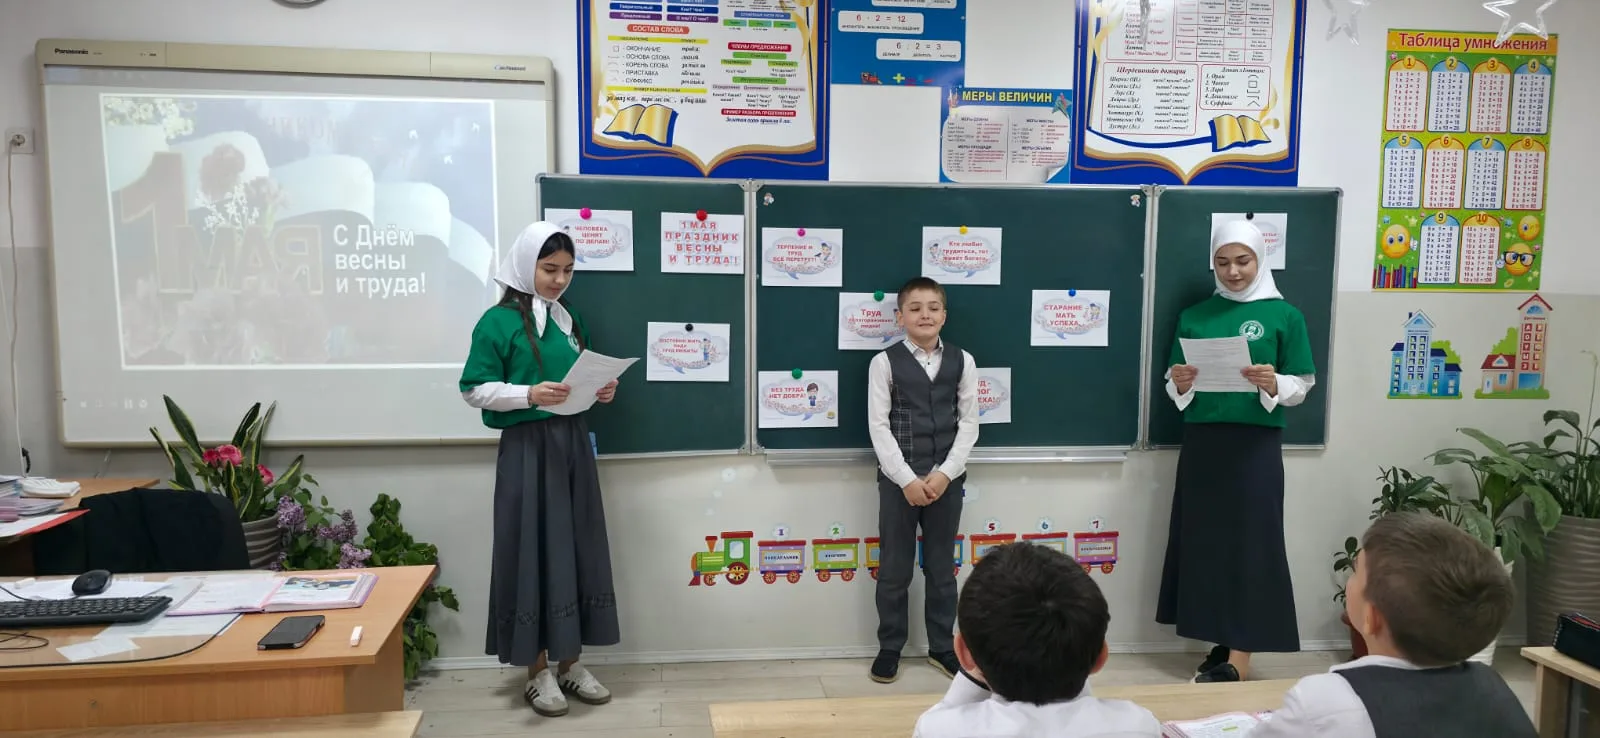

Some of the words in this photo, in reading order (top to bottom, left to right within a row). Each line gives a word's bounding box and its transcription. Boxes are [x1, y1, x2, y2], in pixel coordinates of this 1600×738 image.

[1399, 33, 1460, 51] Таблица
[1464, 37, 1547, 51] умножения
[1408, 58, 1411, 66] 1
[1449, 59, 1454, 67] 2
[1490, 60, 1495, 68] 3
[962, 91, 995, 101] МЕРЫ
[998, 91, 1052, 102] ВЕЛИЧИН
[1478, 214, 1488, 222] 10
[334, 224, 348, 246] С
[356, 223, 414, 250] Днём
[665, 232, 738, 241] ПРАЗДНИК
[677, 244, 722, 252] ВЕСНЫ
[335, 254, 406, 270] весны
[685, 256, 737, 264] ТРУДА!
[336, 277, 348, 294] и
[355, 272, 426, 299] труда!
[989, 523, 995, 531] 5
